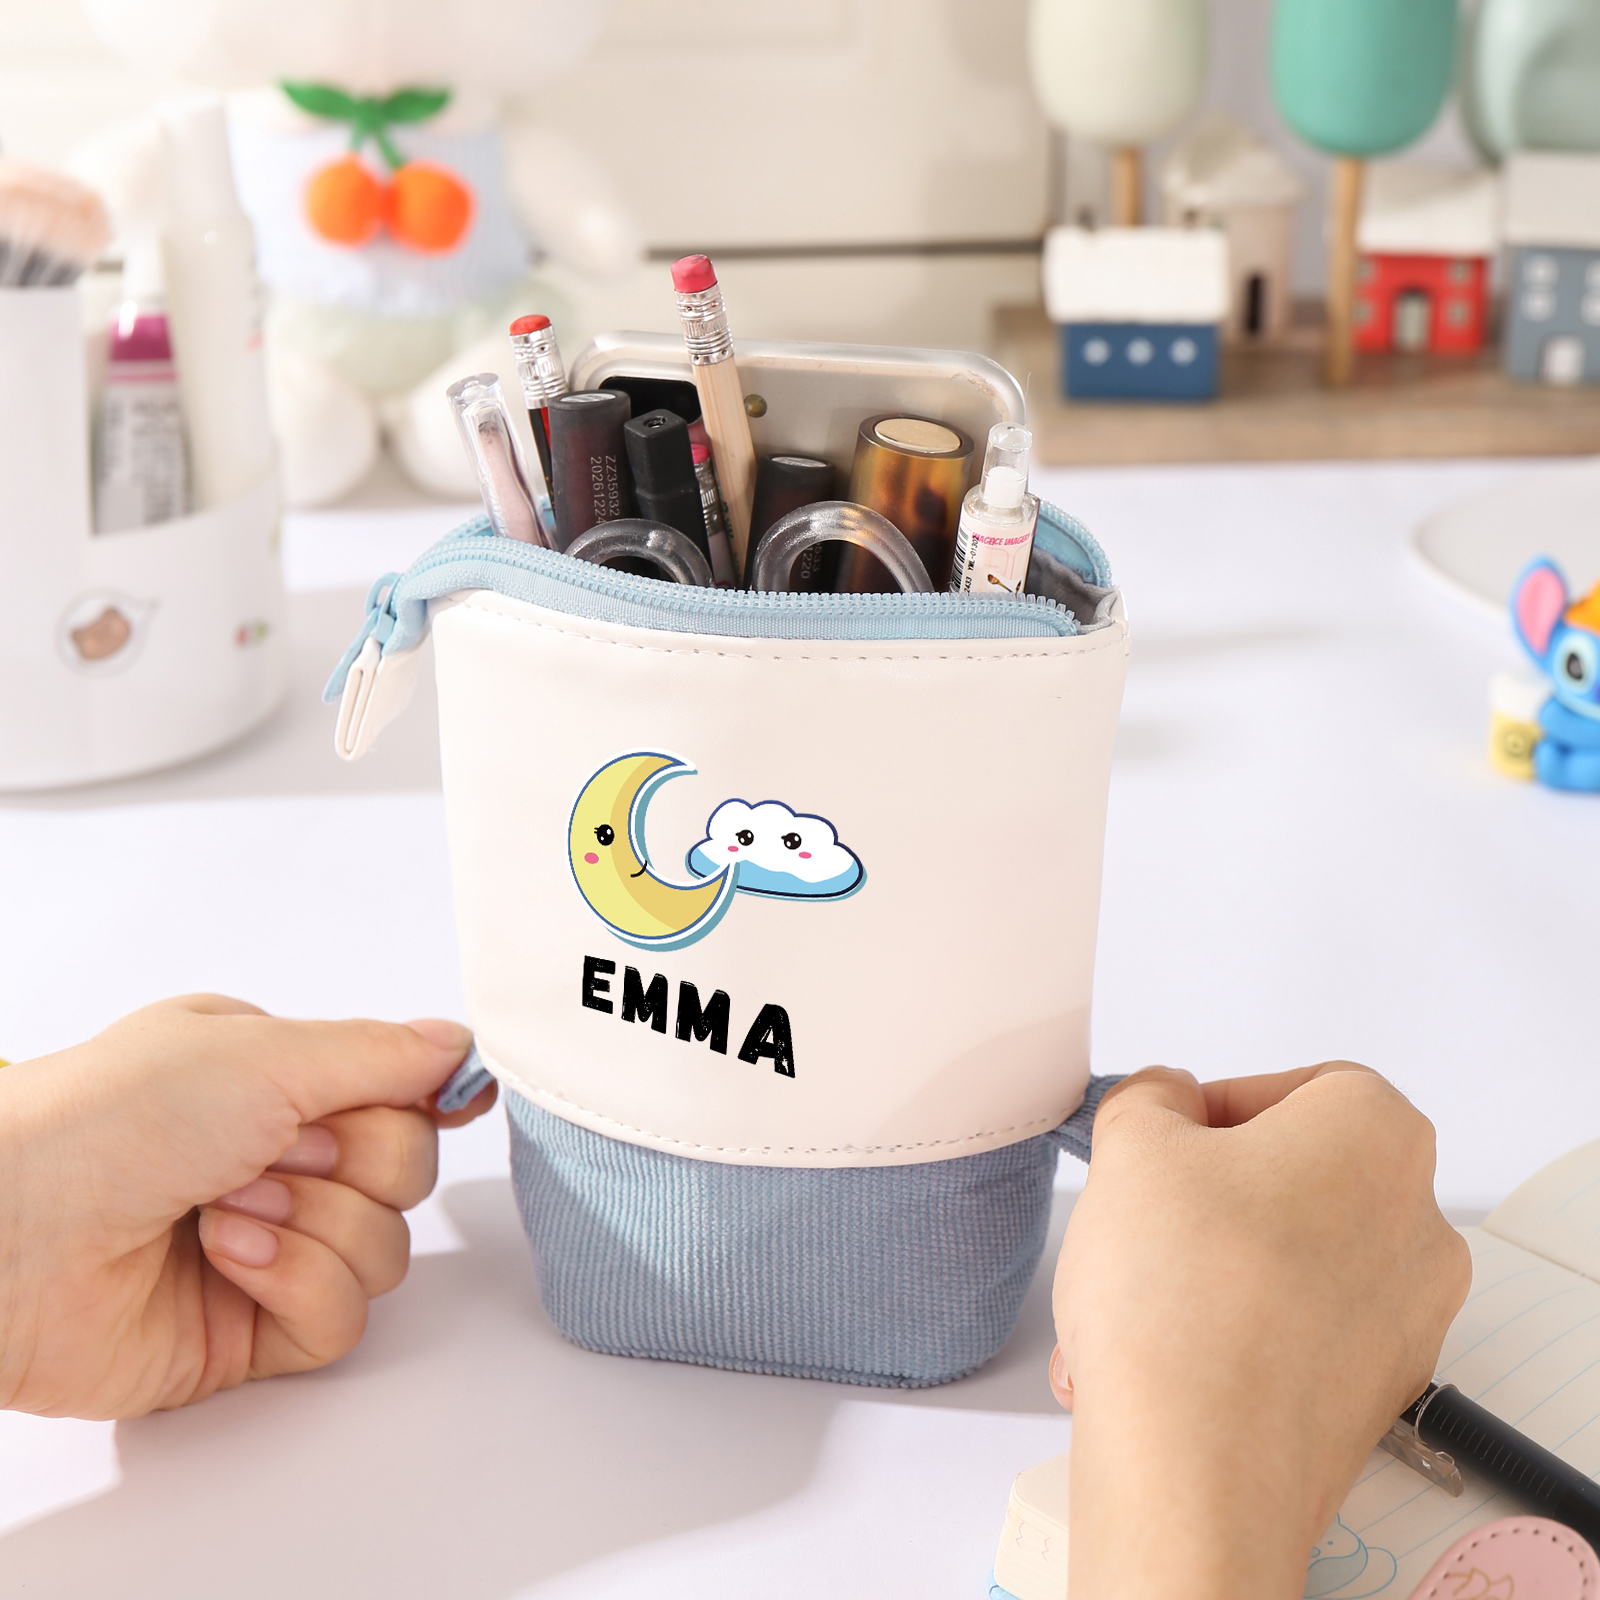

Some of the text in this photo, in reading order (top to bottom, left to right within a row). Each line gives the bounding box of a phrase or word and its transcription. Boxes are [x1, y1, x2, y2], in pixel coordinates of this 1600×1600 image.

[590, 456, 607, 524] 20261224
[605, 455, 620, 517] ZZ35932
[812, 542, 823, 572] 533
[963, 576, 973, 596] 2433
[582, 955, 796, 1079] EMMA
